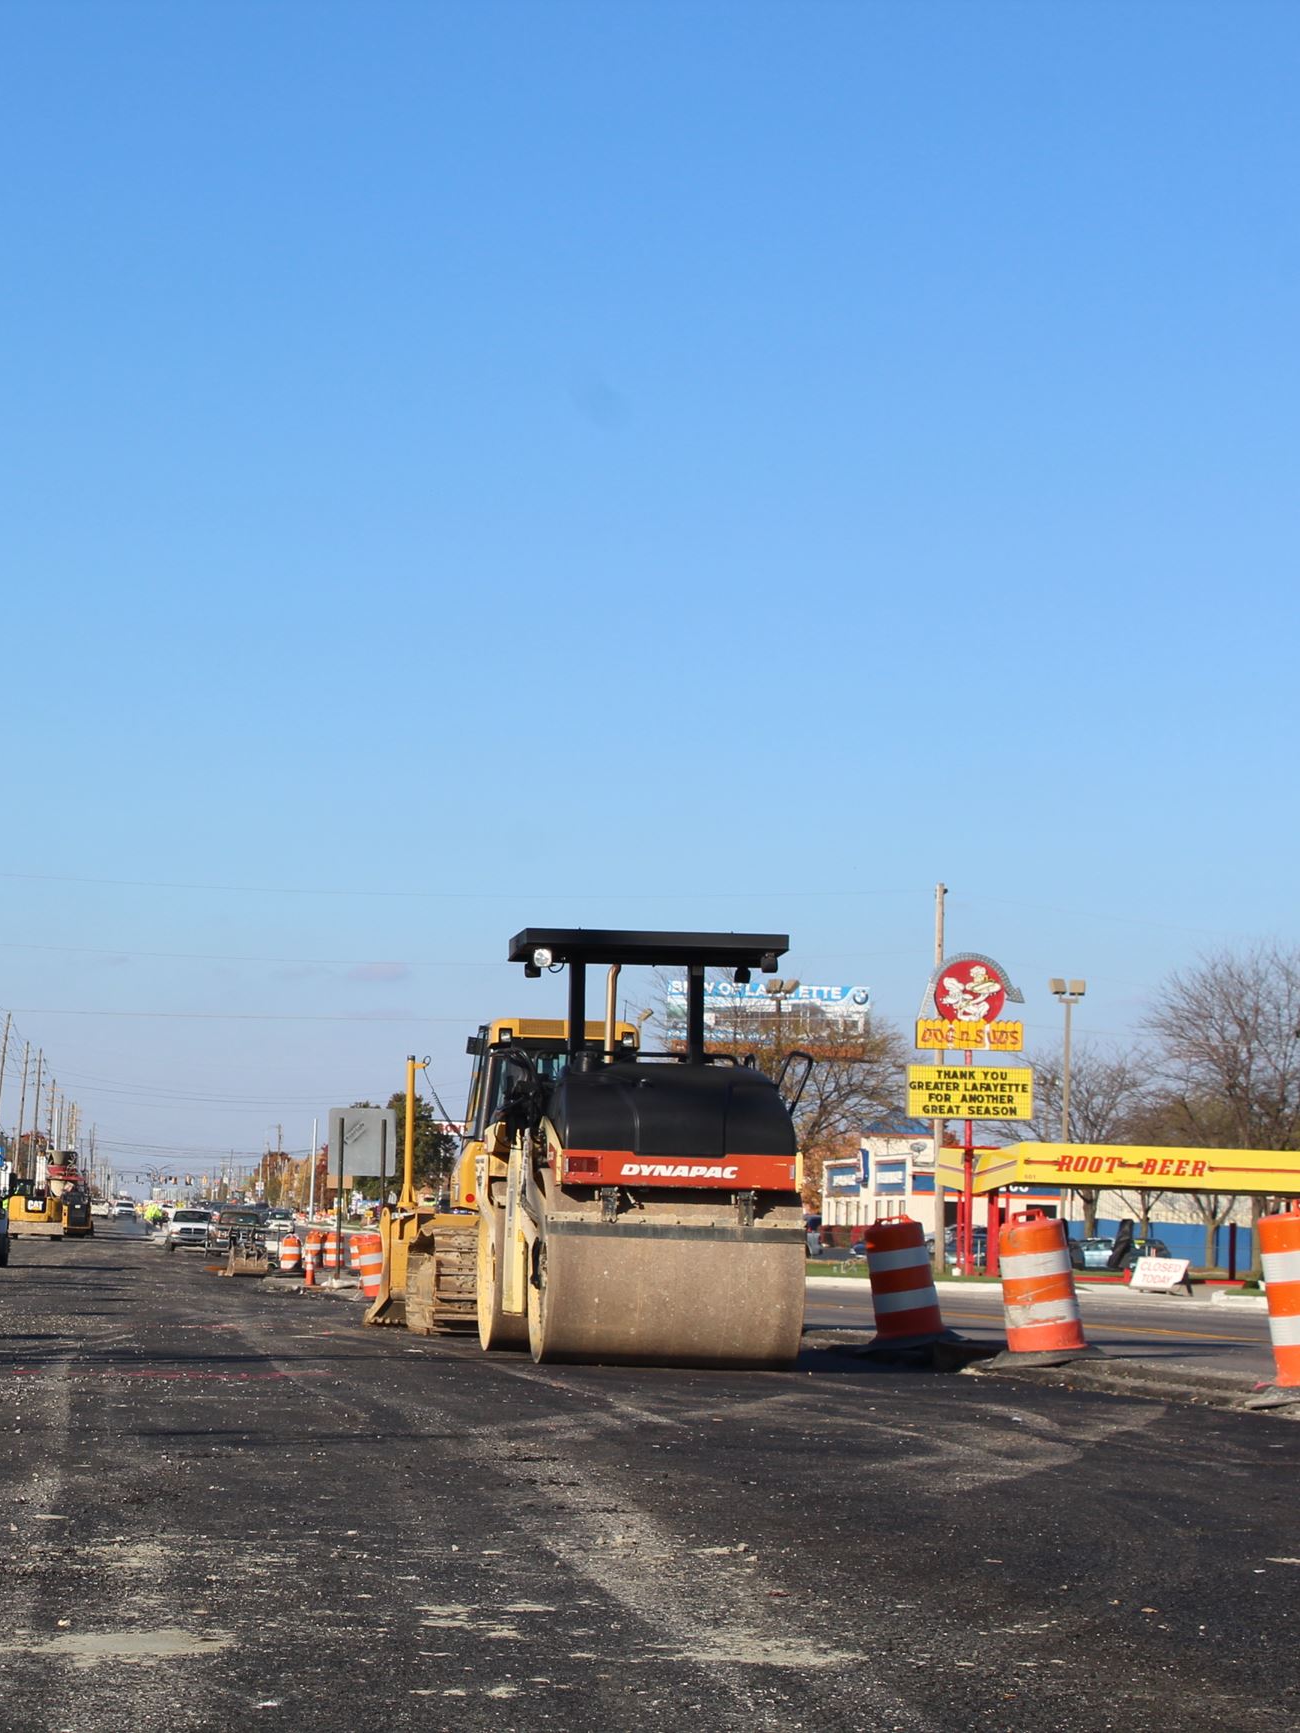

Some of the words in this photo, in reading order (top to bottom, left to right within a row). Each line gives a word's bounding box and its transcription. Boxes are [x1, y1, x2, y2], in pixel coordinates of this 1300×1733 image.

[671, 980, 716, 995] BW
[745, 983, 842, 1000] LAETTE
[936, 1070, 976, 1080] THANK
[982, 1071, 1008, 1081] YOU
[909, 1081, 960, 1091] GREATER
[964, 1082, 1029, 1093] LAFAYETTE
[928, 1093, 951, 1102] FOR
[960, 1094, 1014, 1104] ANOTHER
[922, 1105, 960, 1114] GREAT
[967, 1106, 1017, 1116] SEASON
[620, 1163, 739, 1179] DYNAPAC
[1056, 1155, 1123, 1174] ROOT
[1141, 1158, 1207, 1177] BEER
[27, 1200, 44, 1210] CAT
[1140, 1261, 1181, 1273] CLOSED
[1141, 1274, 1173, 1285] TODAY
